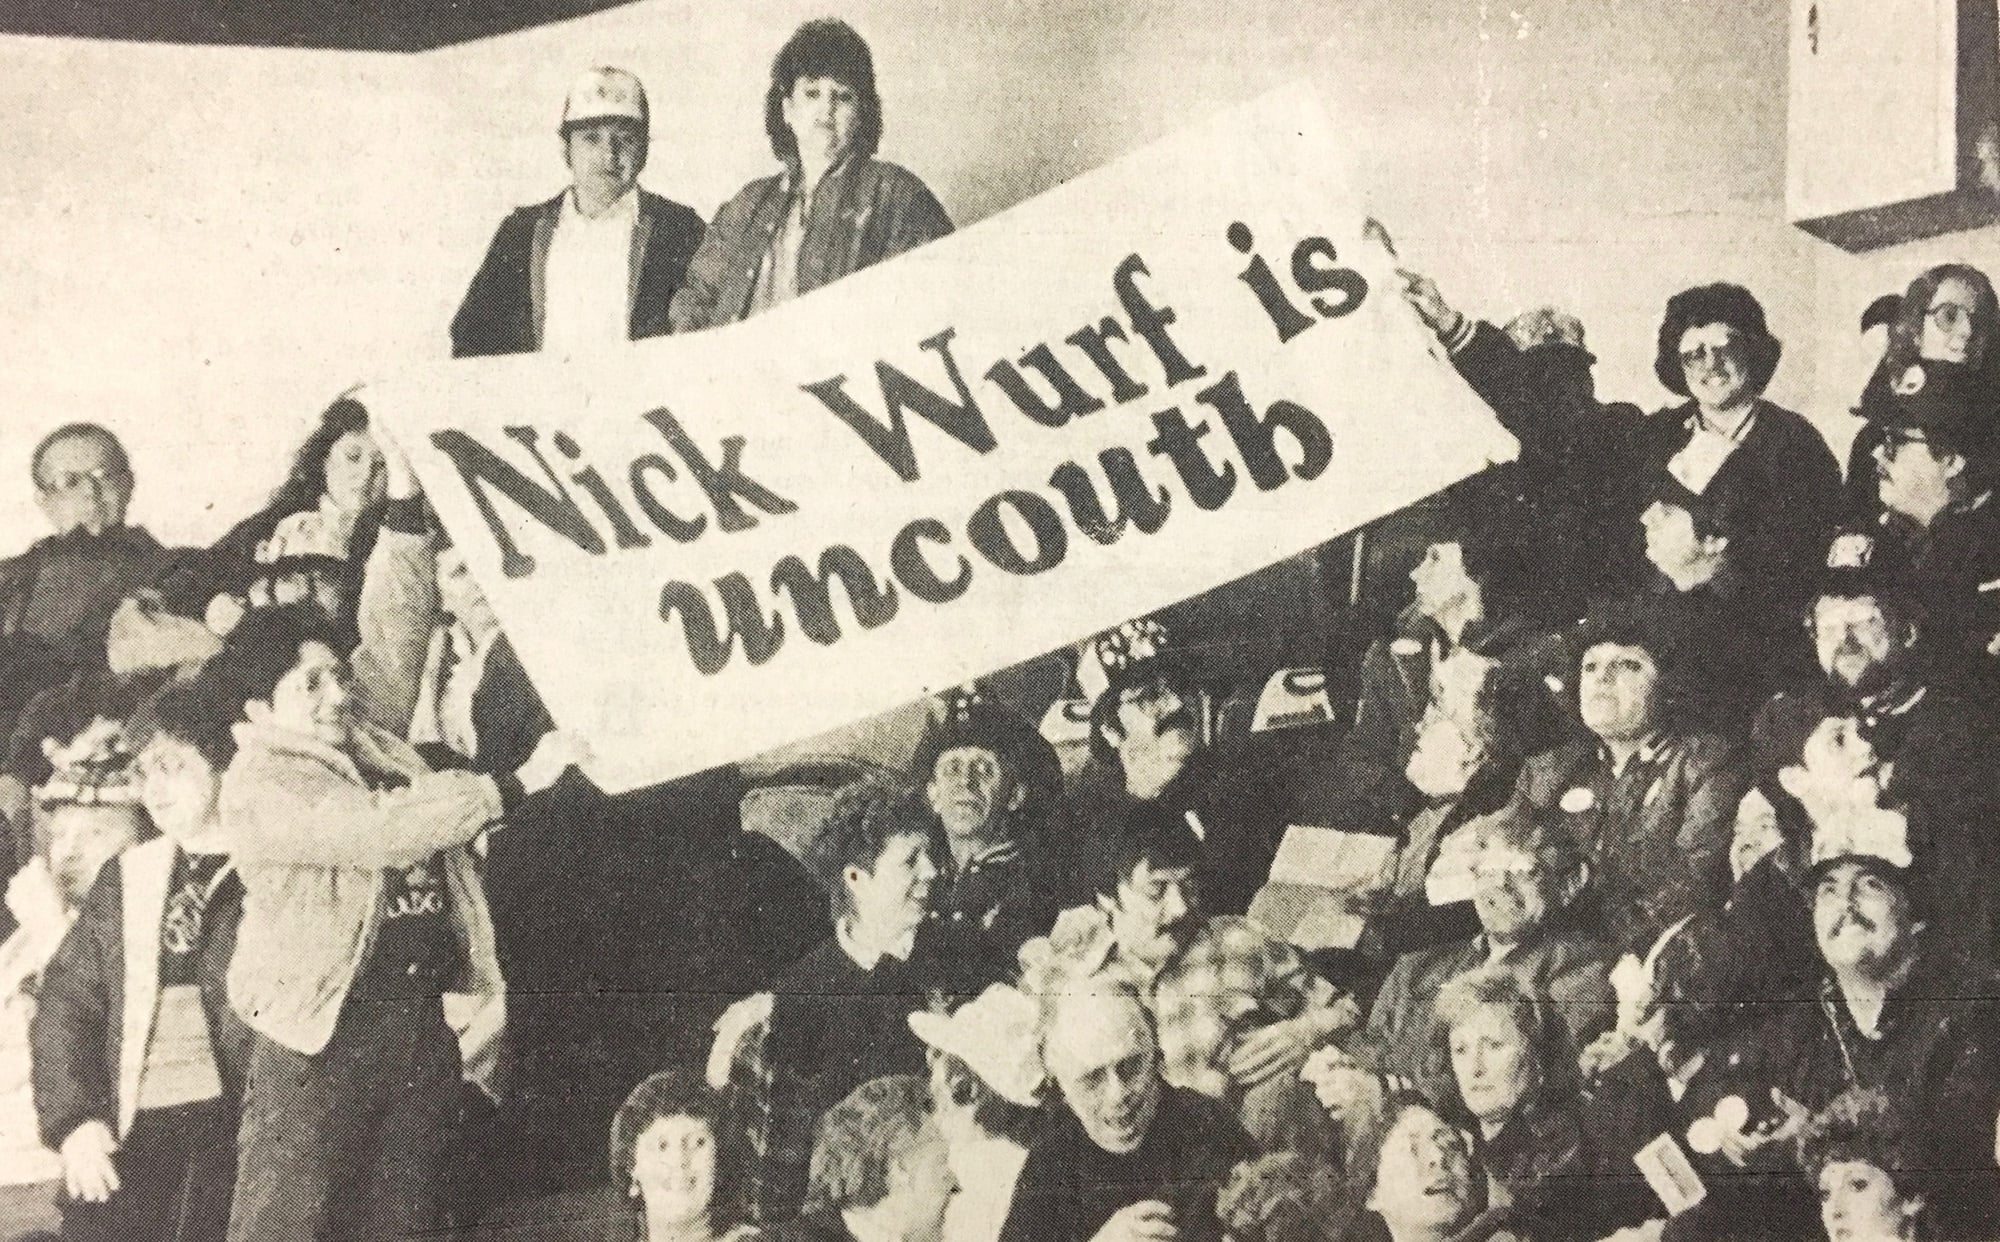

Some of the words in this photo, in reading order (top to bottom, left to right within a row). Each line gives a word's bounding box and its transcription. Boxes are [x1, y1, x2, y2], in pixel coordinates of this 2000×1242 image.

[430, 407, 798, 578] Nick
[799, 252, 1207, 483] Wurf
[1226, 221, 1369, 344] is
[659, 371, 1334, 675] uncouth
